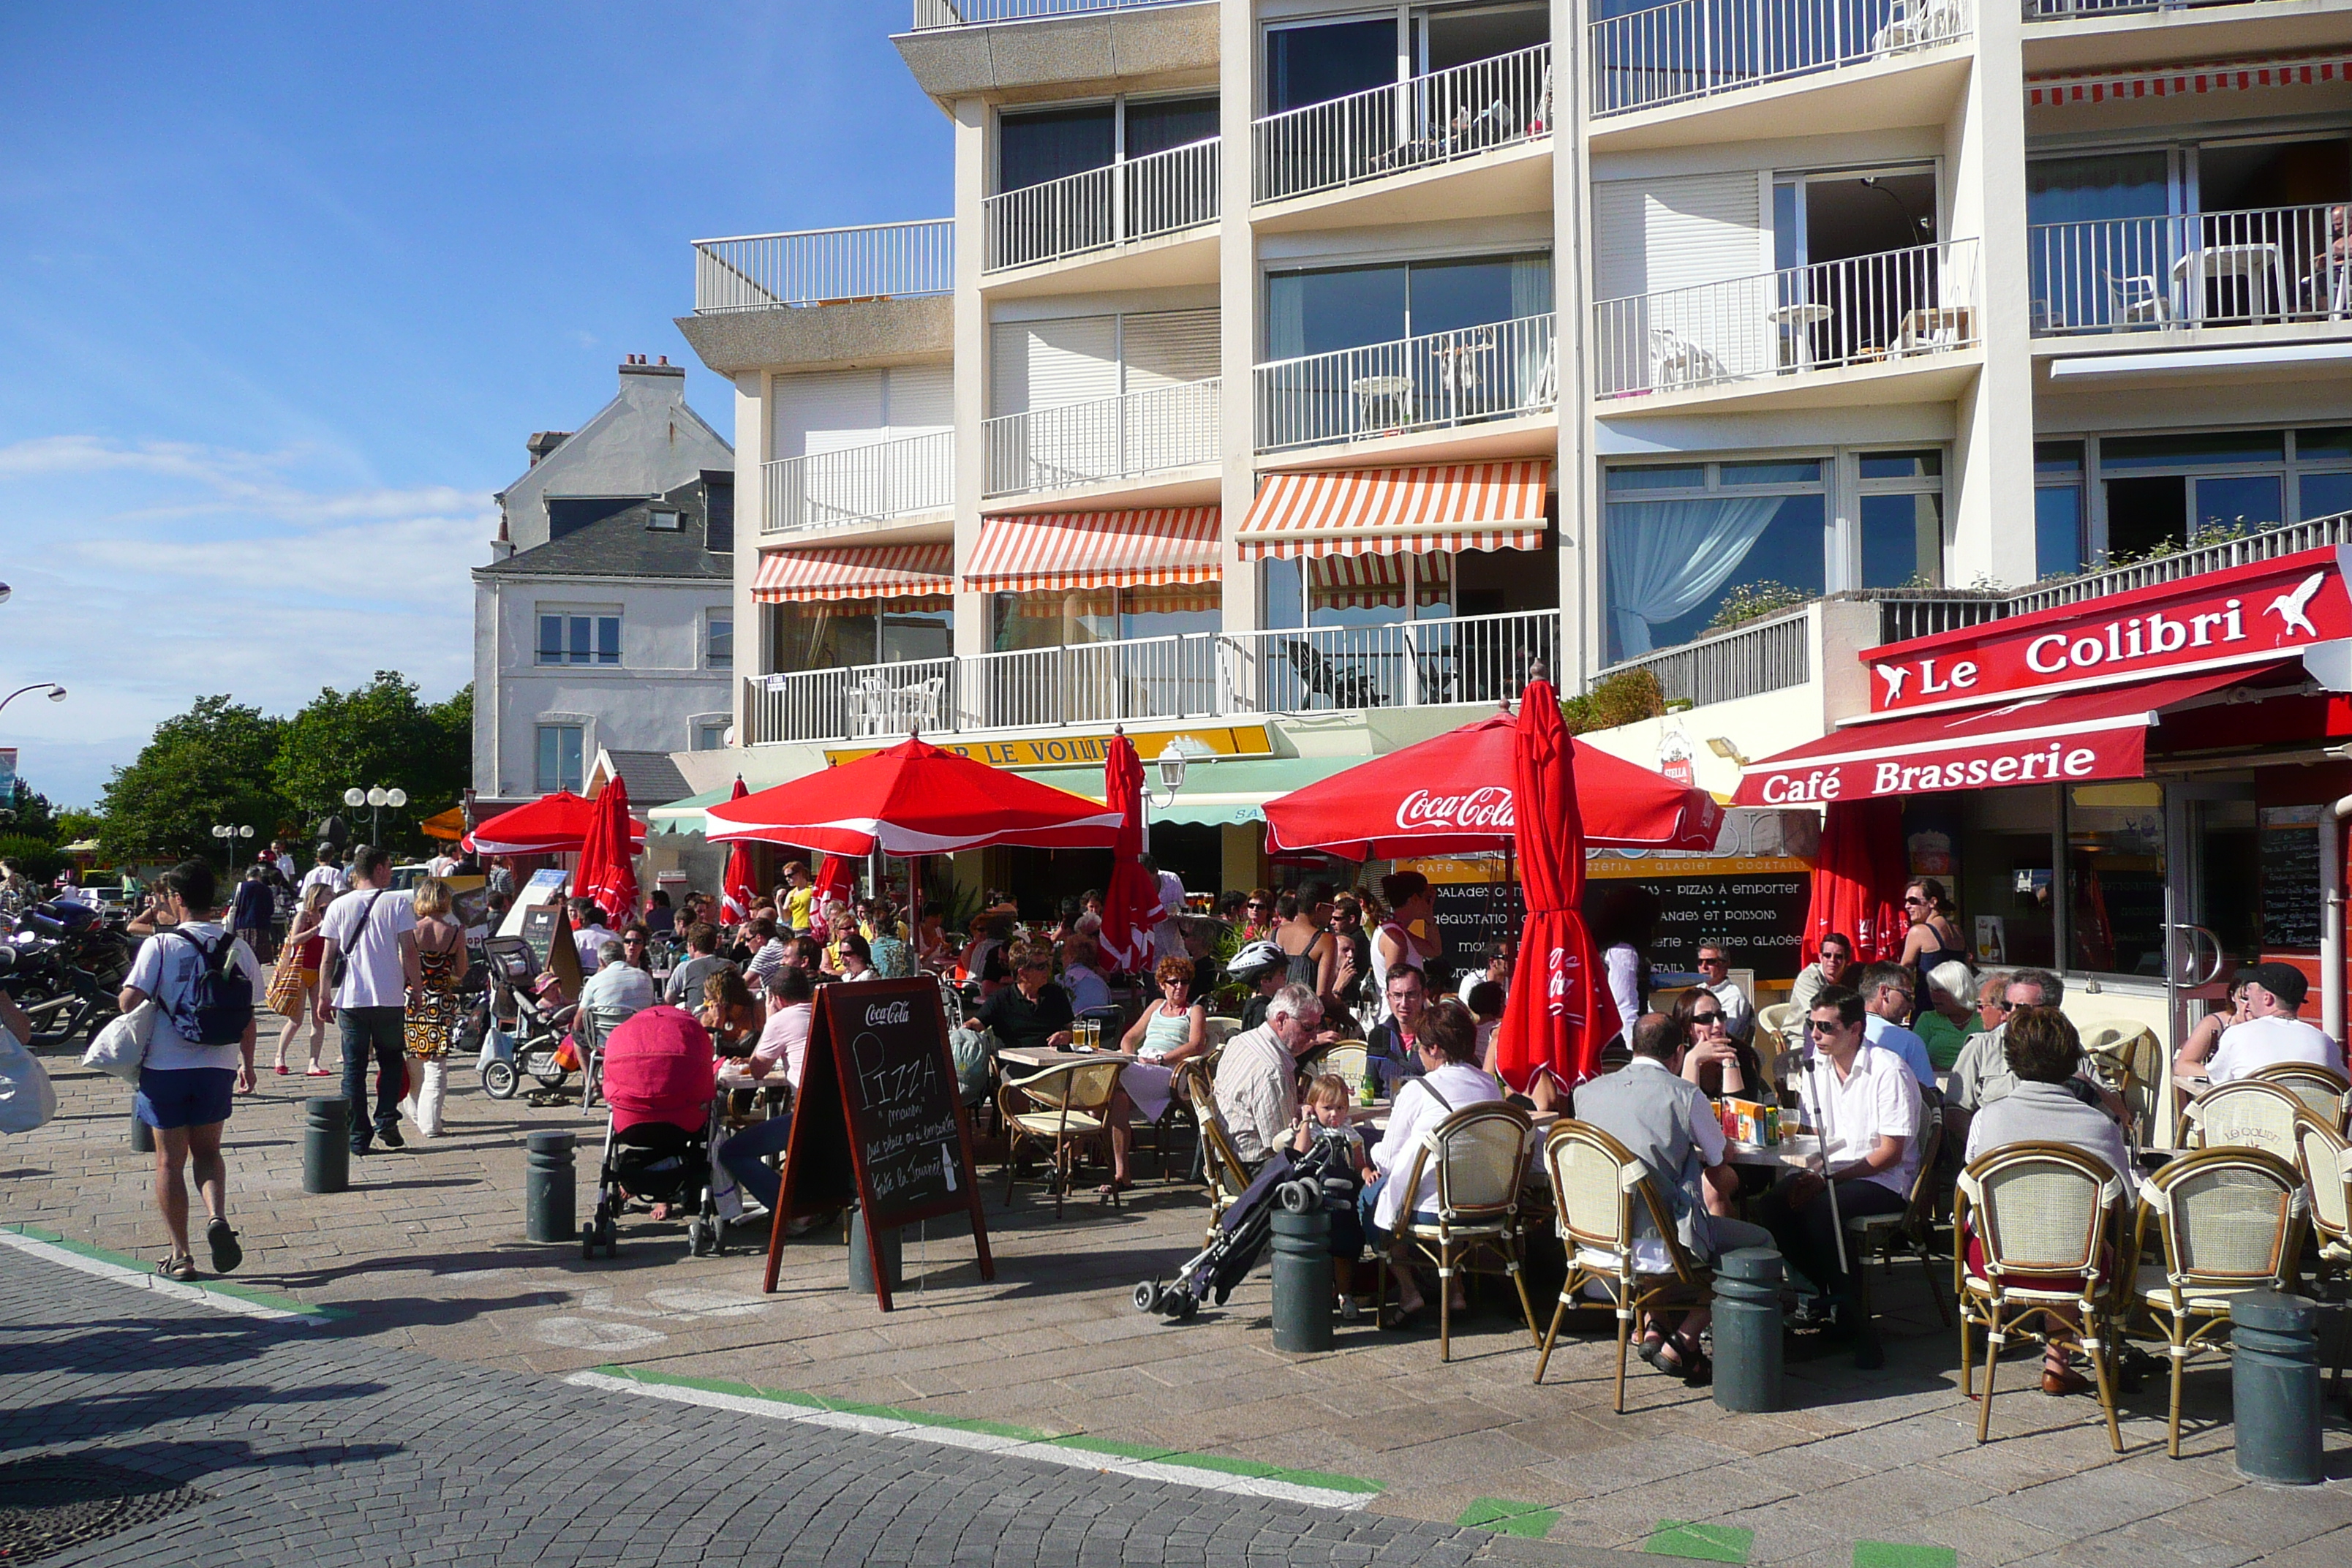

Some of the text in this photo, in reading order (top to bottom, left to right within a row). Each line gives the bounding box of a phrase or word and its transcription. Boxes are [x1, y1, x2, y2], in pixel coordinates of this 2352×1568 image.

[1920, 598, 2247, 696] Le Colibri
[984, 743, 1019, 764] LE
[1762, 742, 2097, 806] Café Brasserie
[865, 1000, 910, 1027] Coca-Cola
